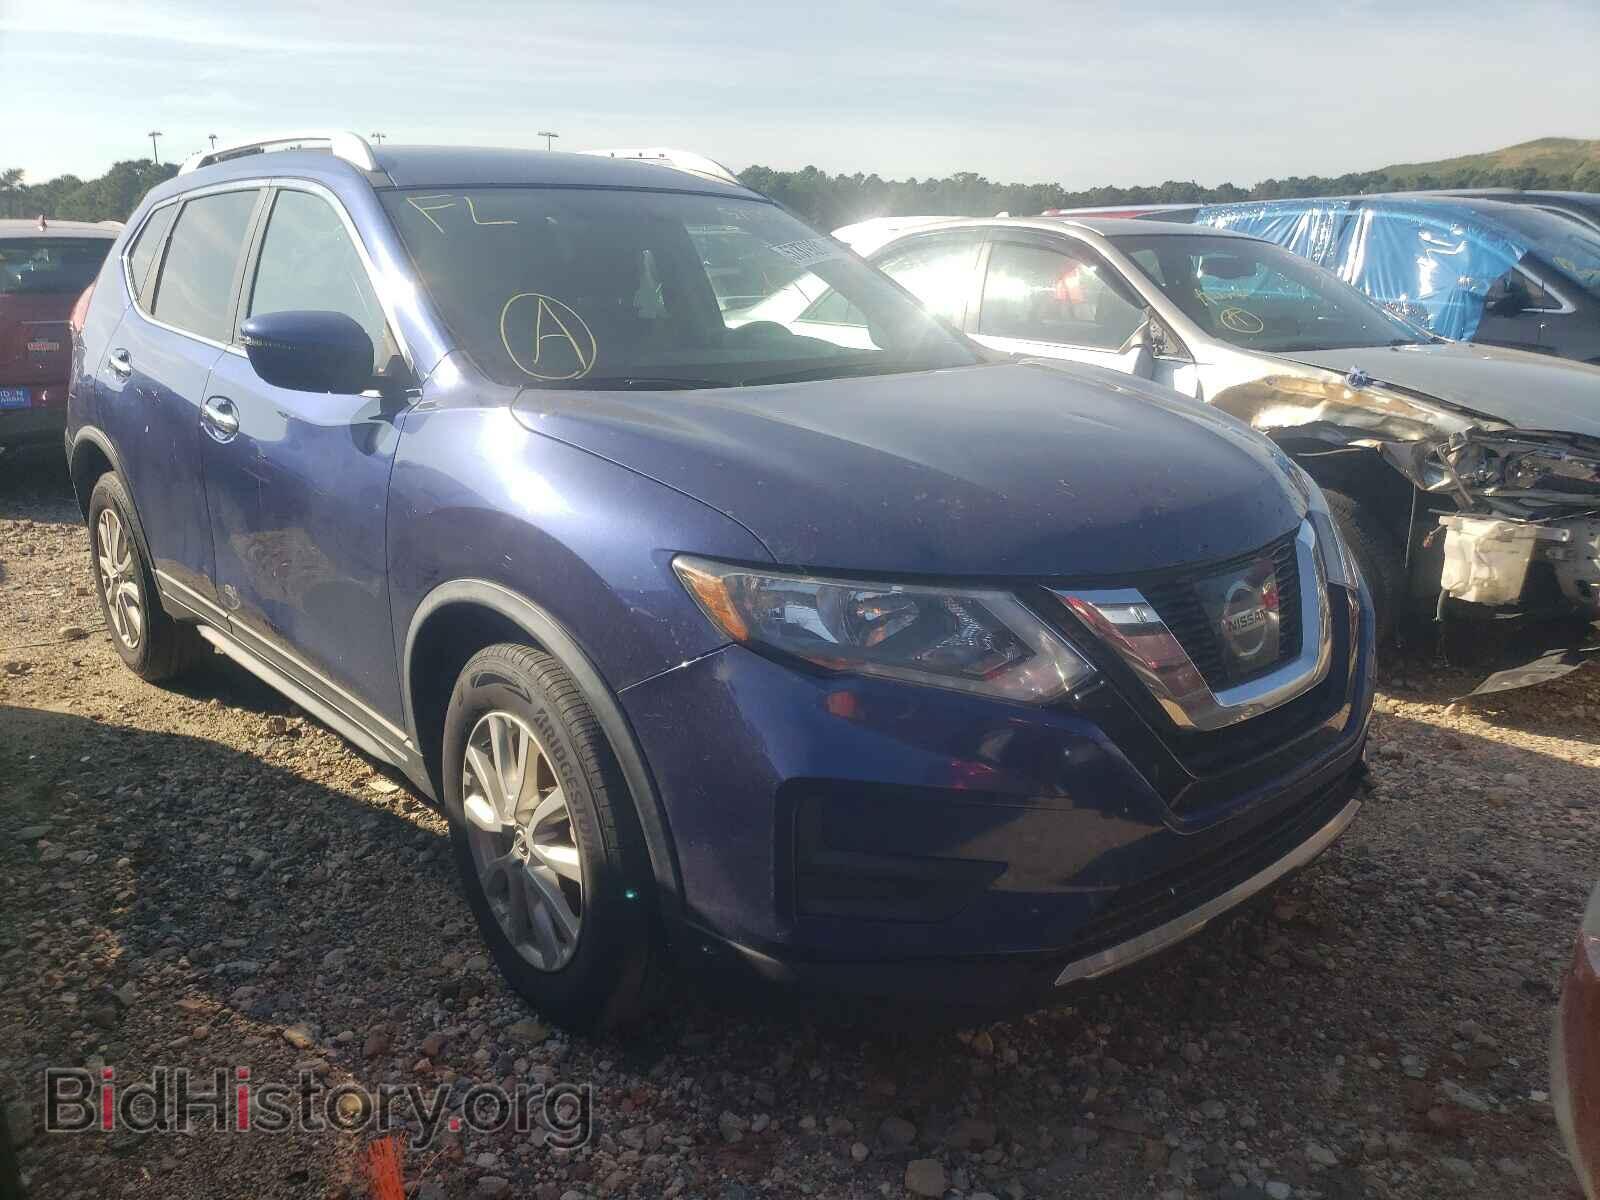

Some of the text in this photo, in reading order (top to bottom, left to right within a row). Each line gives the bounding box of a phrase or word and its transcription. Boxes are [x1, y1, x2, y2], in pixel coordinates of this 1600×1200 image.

[406, 194, 518, 234] FL
[532, 297, 588, 370] A
[1227, 609, 1265, 633] NISSAN
